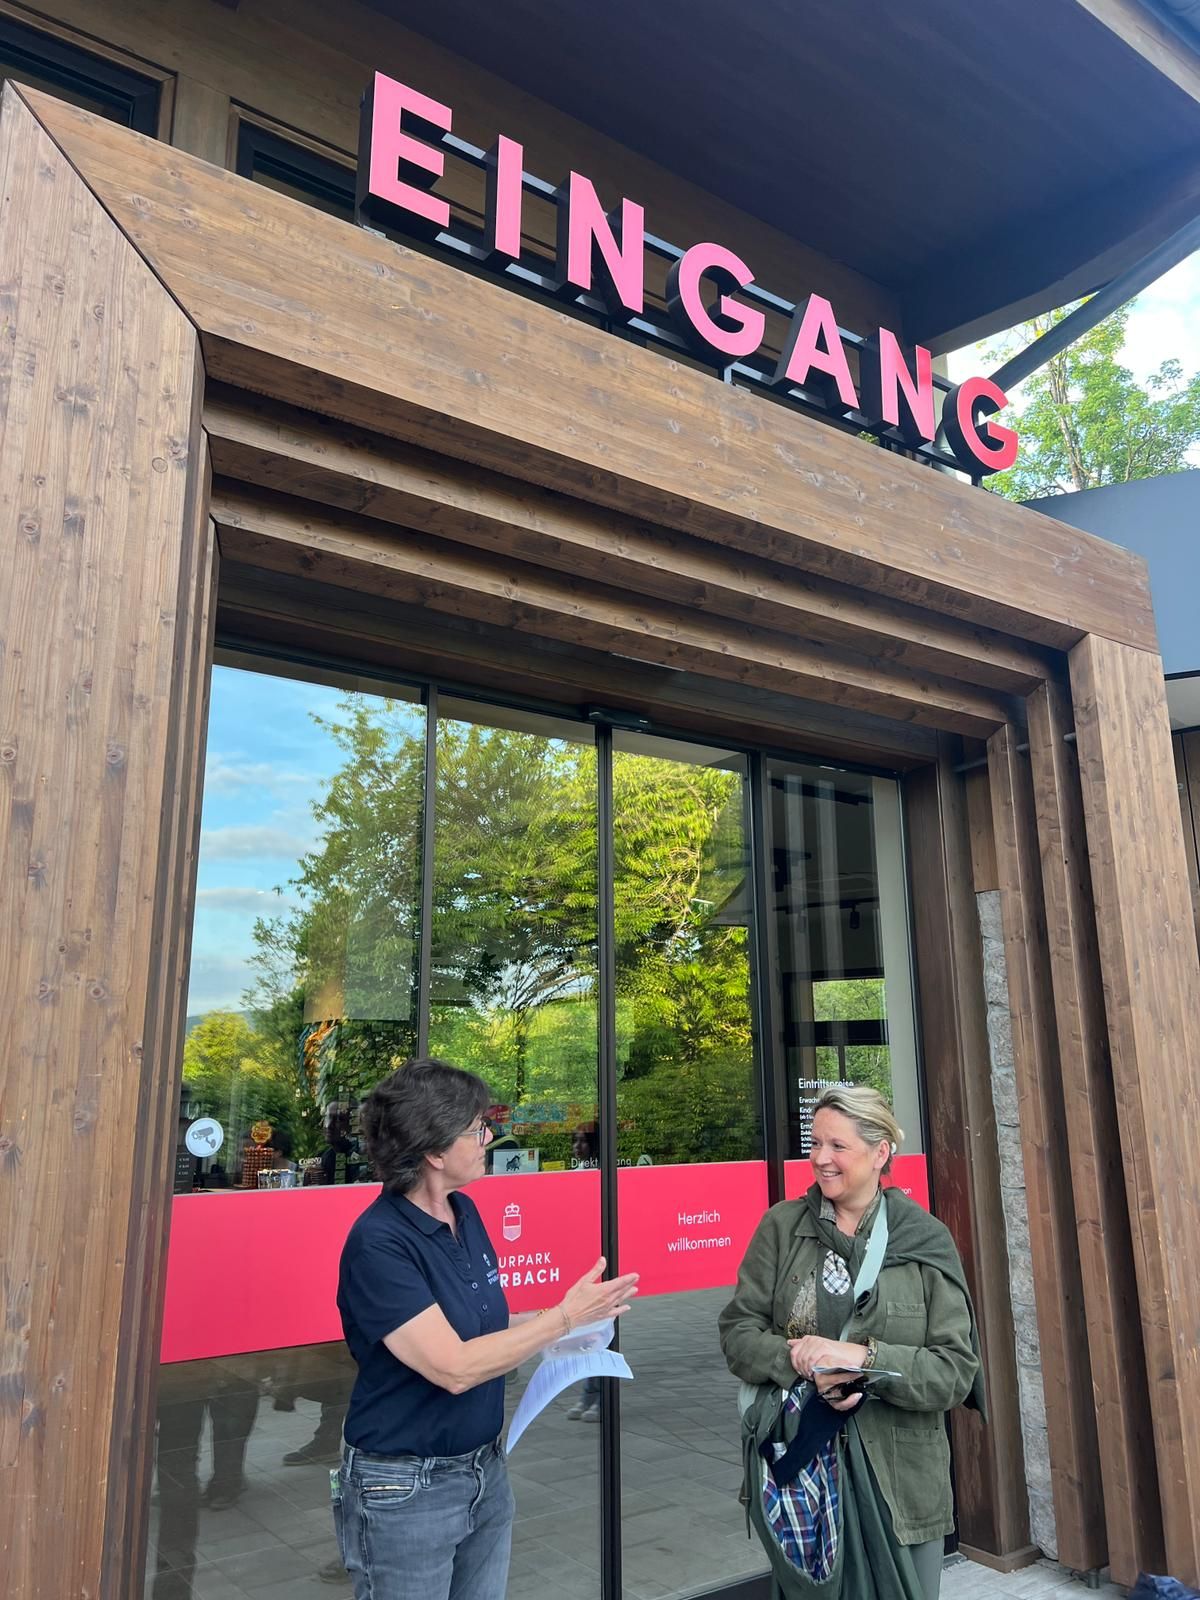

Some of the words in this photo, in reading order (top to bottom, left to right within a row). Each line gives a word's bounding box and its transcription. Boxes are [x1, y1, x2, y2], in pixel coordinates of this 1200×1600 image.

[368, 70, 1018, 471] EINGANG
[799, 1096, 818, 1104] Erwach
[677, 1209, 721, 1225] Herzlich
[667, 1236, 732, 1252] willkommen
[498, 1252, 551, 1269] URPARK
[499, 1267, 560, 1288] RBACH
